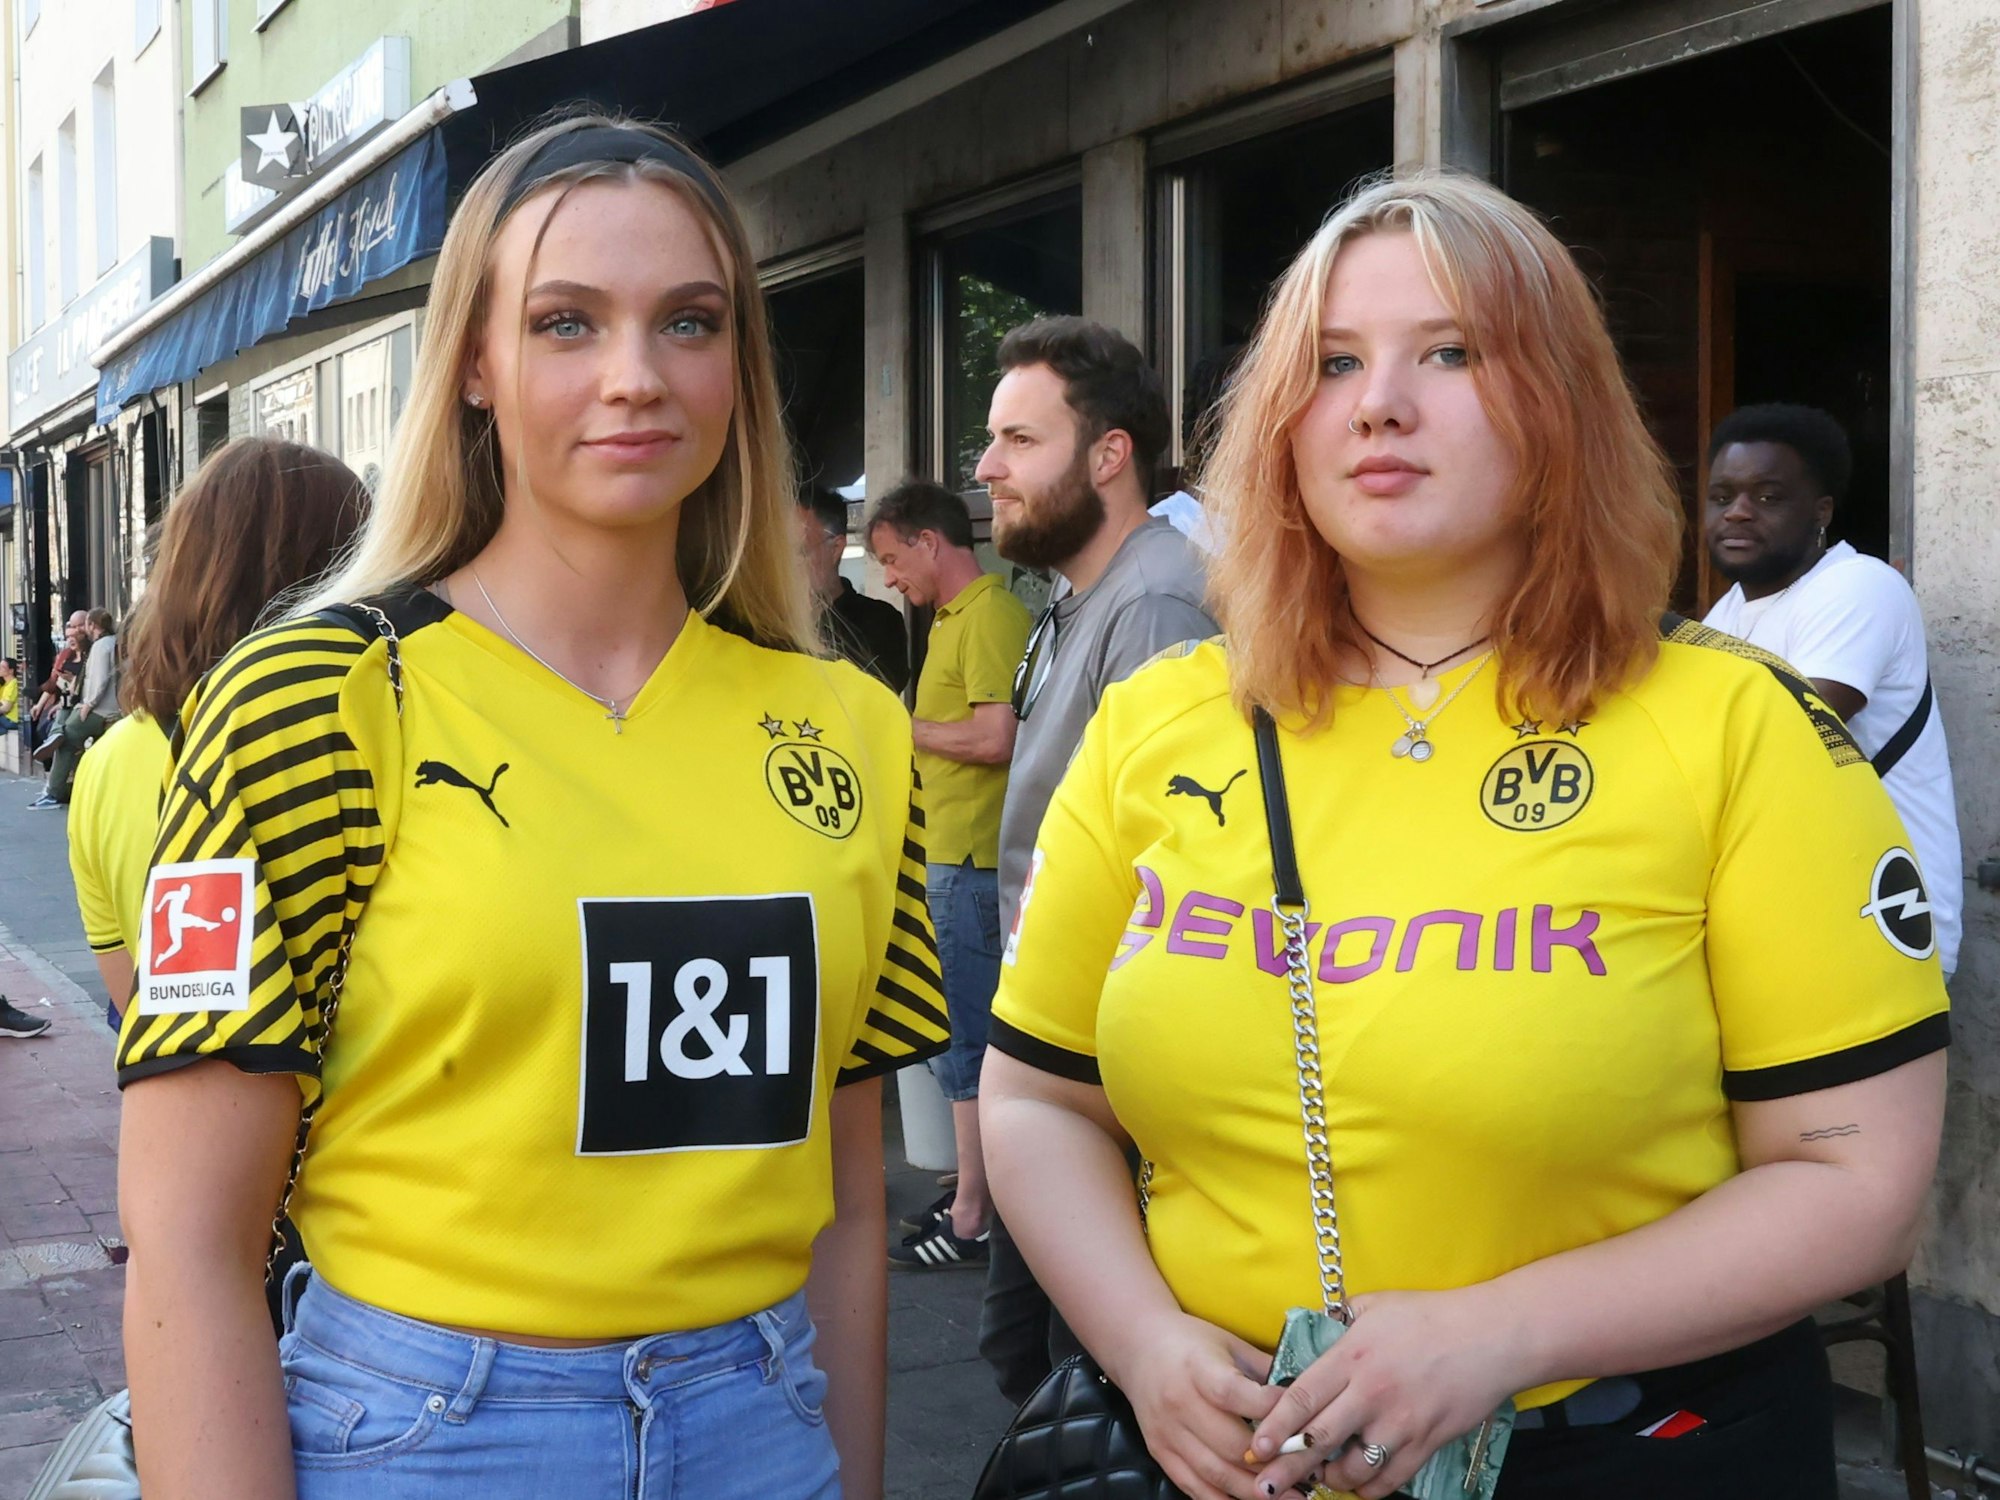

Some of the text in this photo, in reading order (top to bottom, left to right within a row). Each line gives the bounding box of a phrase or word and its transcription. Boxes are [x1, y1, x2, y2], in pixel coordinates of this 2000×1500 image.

[778, 750, 855, 811] BVB
[1493, 747, 1582, 806] BVB
[815, 805, 840, 829] 09
[1513, 802, 1546, 823] 09
[1166, 890, 1606, 984] EVONIK
[149, 982, 235, 1001] BUNDESLIGA
[608, 955, 790, 1083] 1&1
